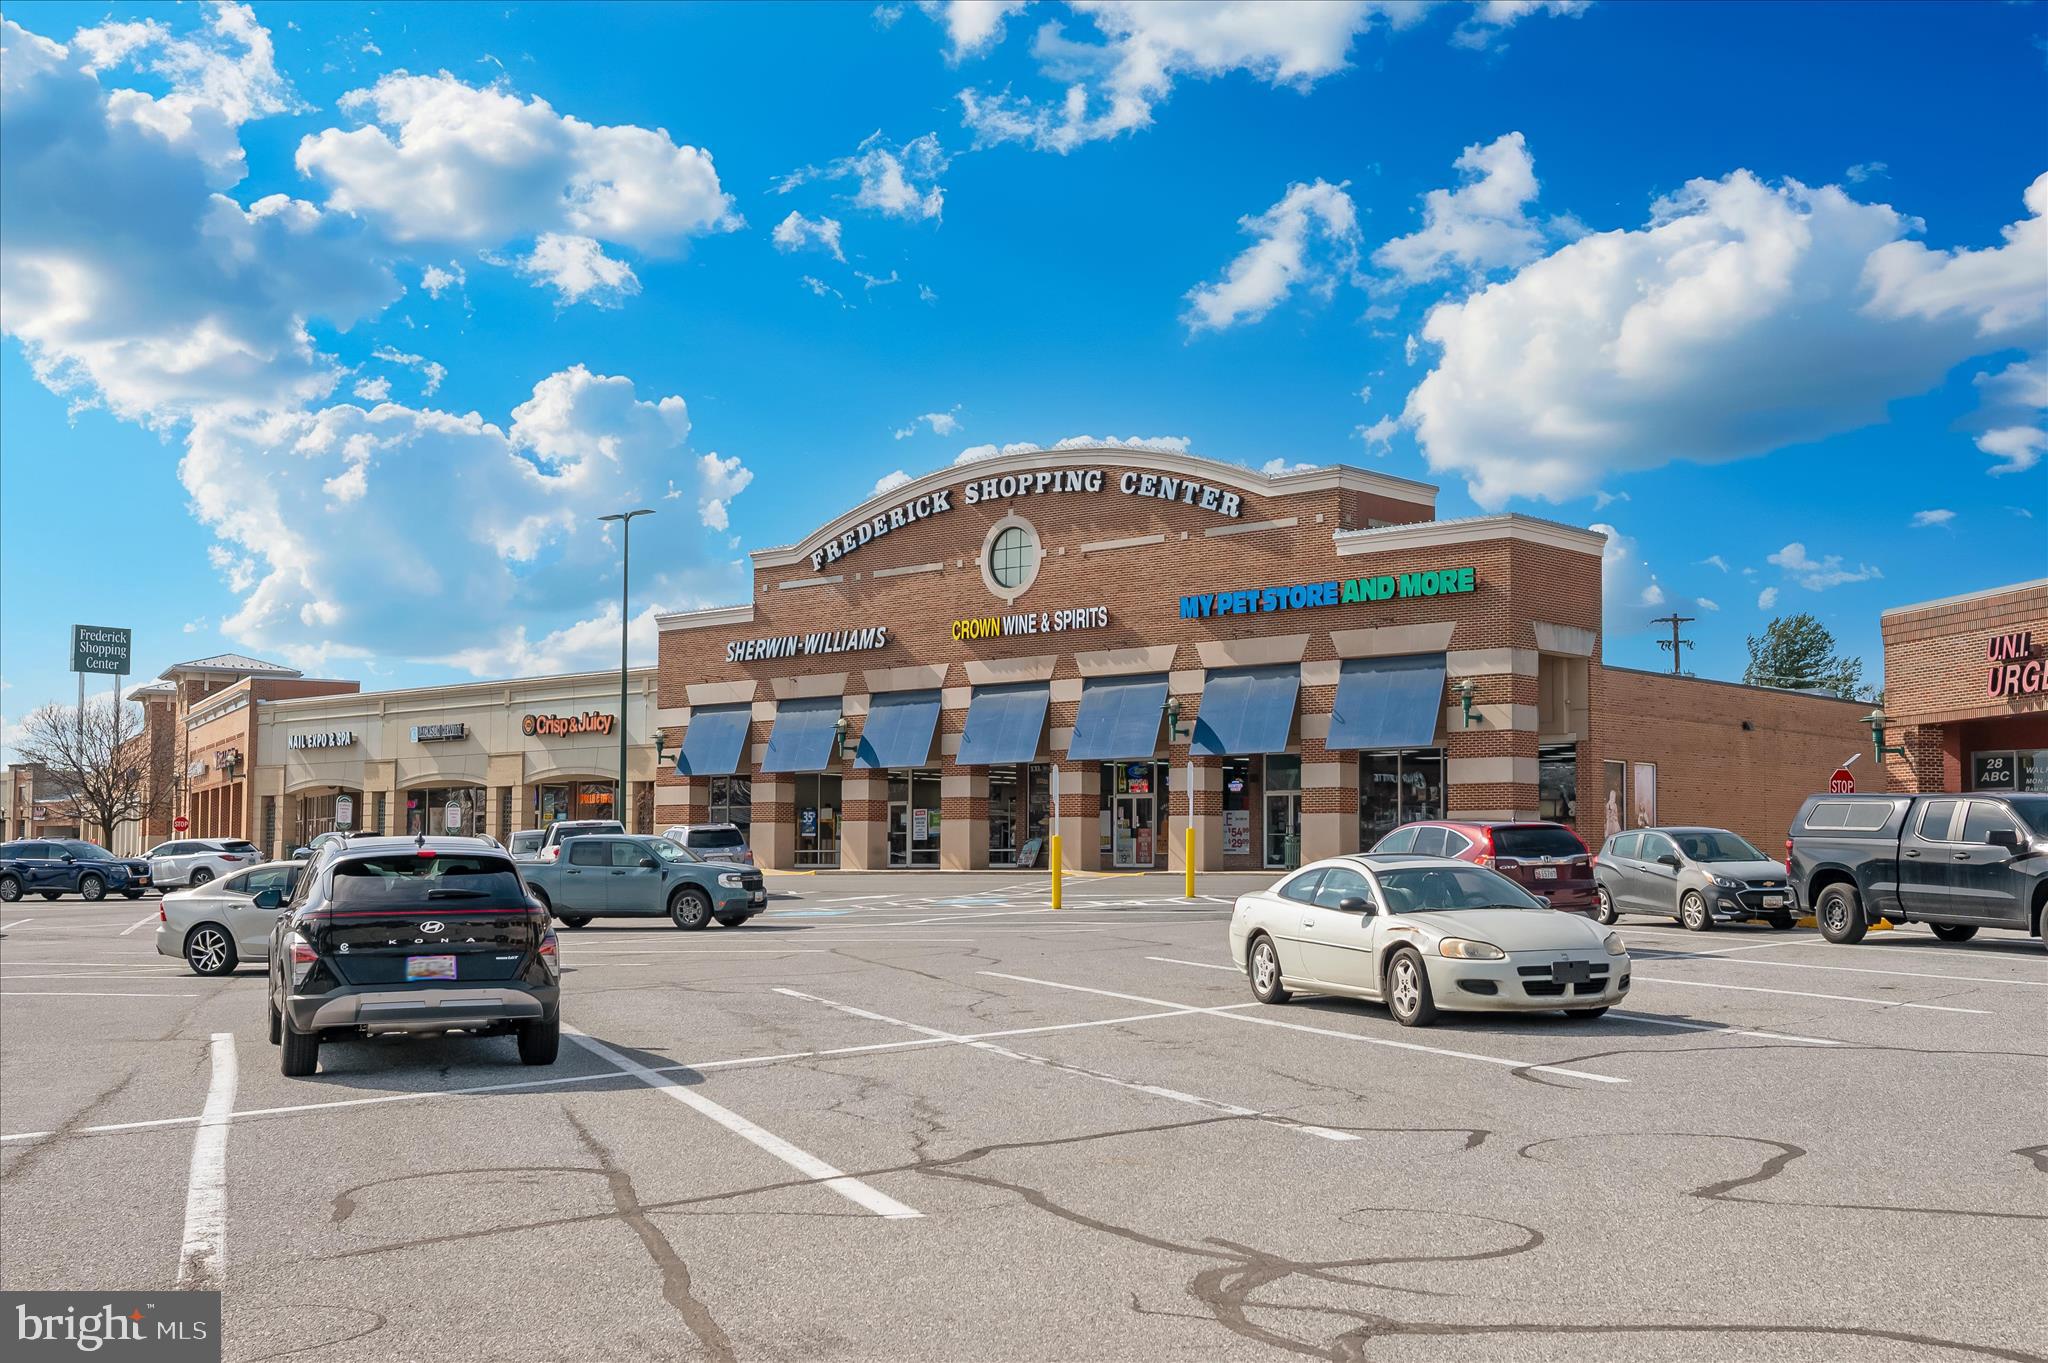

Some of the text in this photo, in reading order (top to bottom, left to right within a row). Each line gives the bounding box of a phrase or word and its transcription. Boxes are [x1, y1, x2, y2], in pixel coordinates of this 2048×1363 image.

[810, 470, 1242, 571] FREDERICK SHOPPING CENTER
[1179, 567, 1476, 619] MY PET STORE AND MORE
[951, 606, 1108, 641] CROWN WINE & SPIRITS
[80, 628, 127, 643] Frederick
[79, 641, 127, 659] Shopping
[725, 626, 888, 663] SHERWIN-WILLIAMS
[86, 656, 119, 670] Center
[288, 730, 351, 749] NAIL EXPO & SPA
[1986, 758, 2003, 770] 28
[1980, 770, 2011, 783] ABC
[1831, 779, 1854, 793] STOP
[388, 937, 476, 945] KONA
